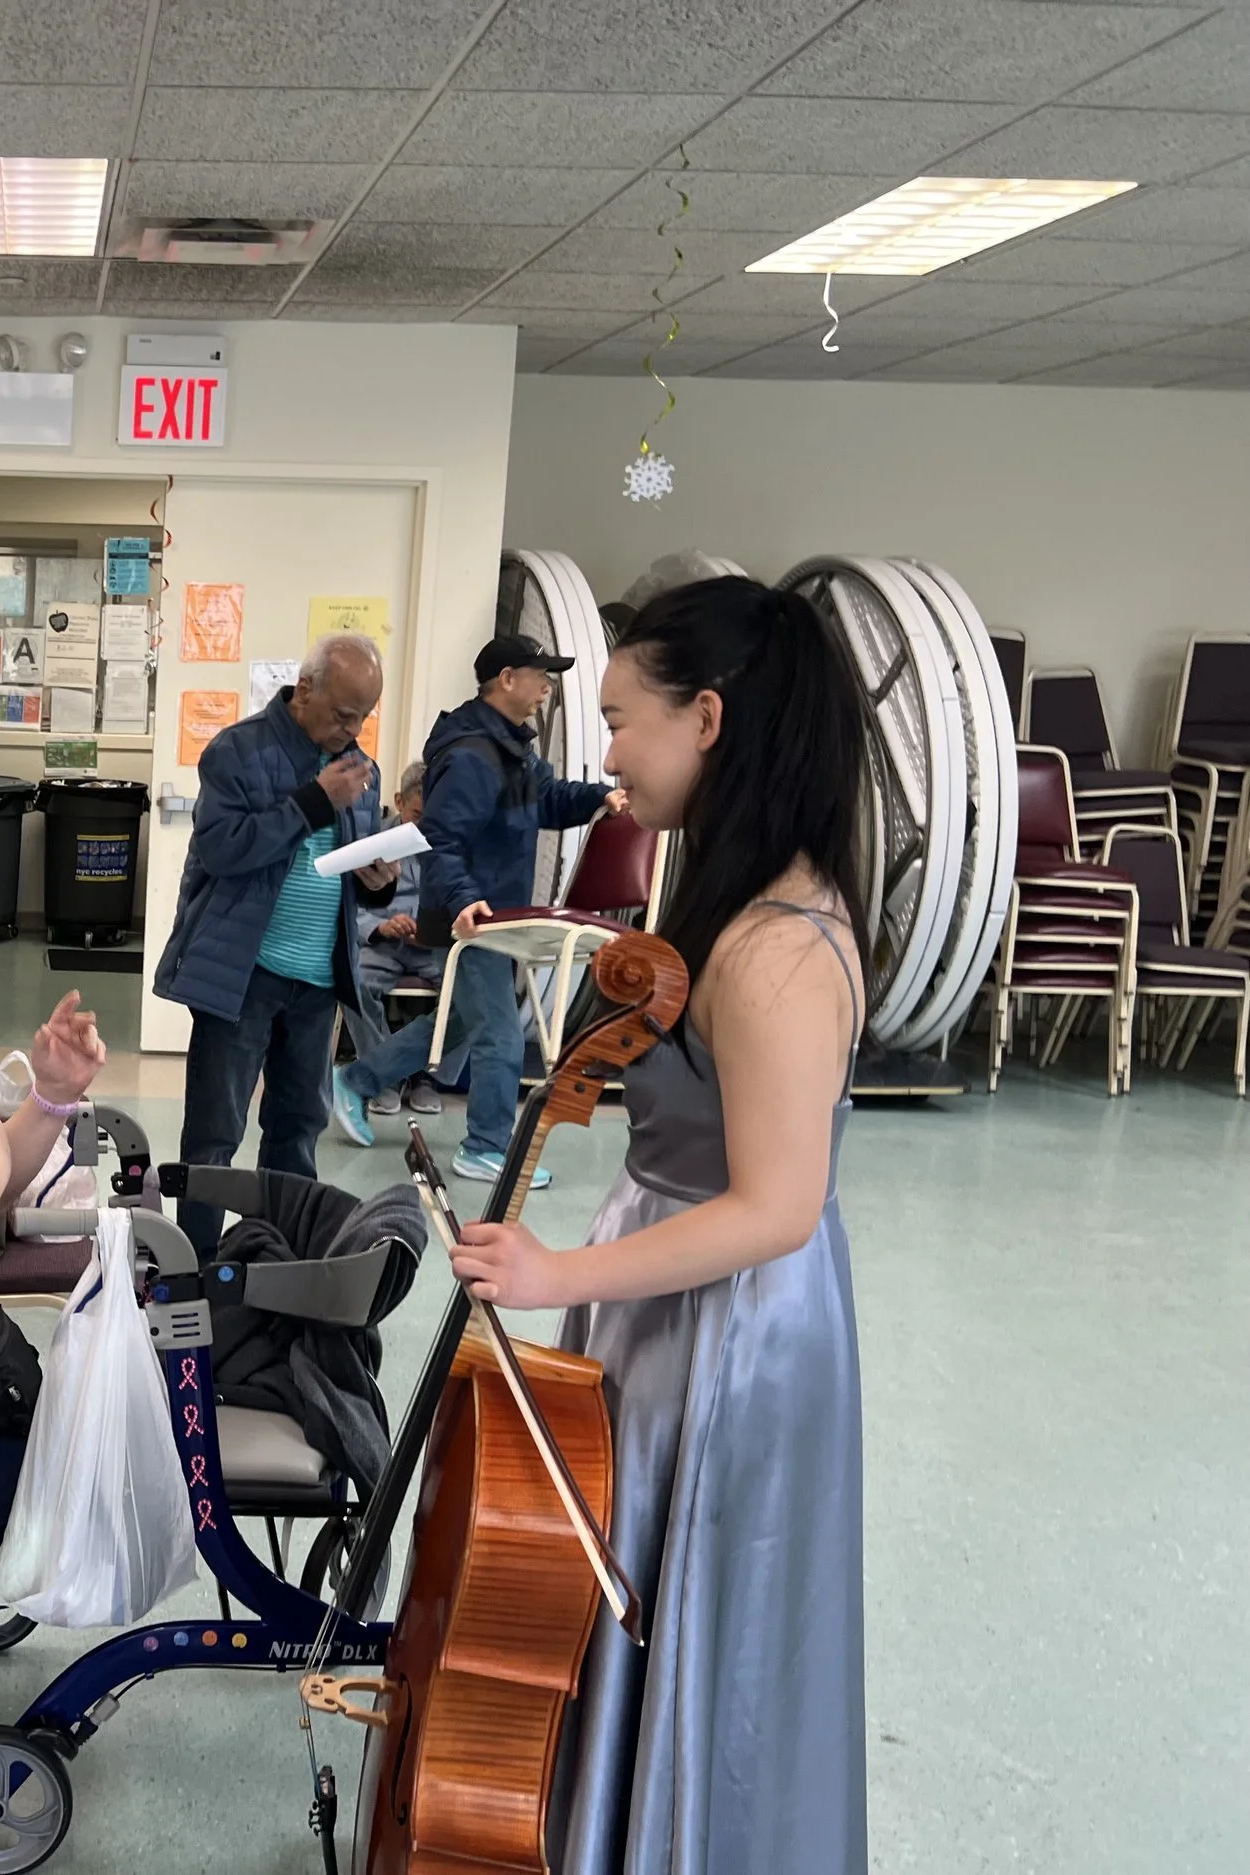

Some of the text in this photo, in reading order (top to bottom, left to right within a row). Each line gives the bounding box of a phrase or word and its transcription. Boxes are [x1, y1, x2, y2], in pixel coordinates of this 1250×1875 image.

[133, 377, 219, 441] EXIT
[13, 637, 36, 664] A
[76, 867, 123, 877] nyc recycles
[341, 1644, 378, 1661] DLX
